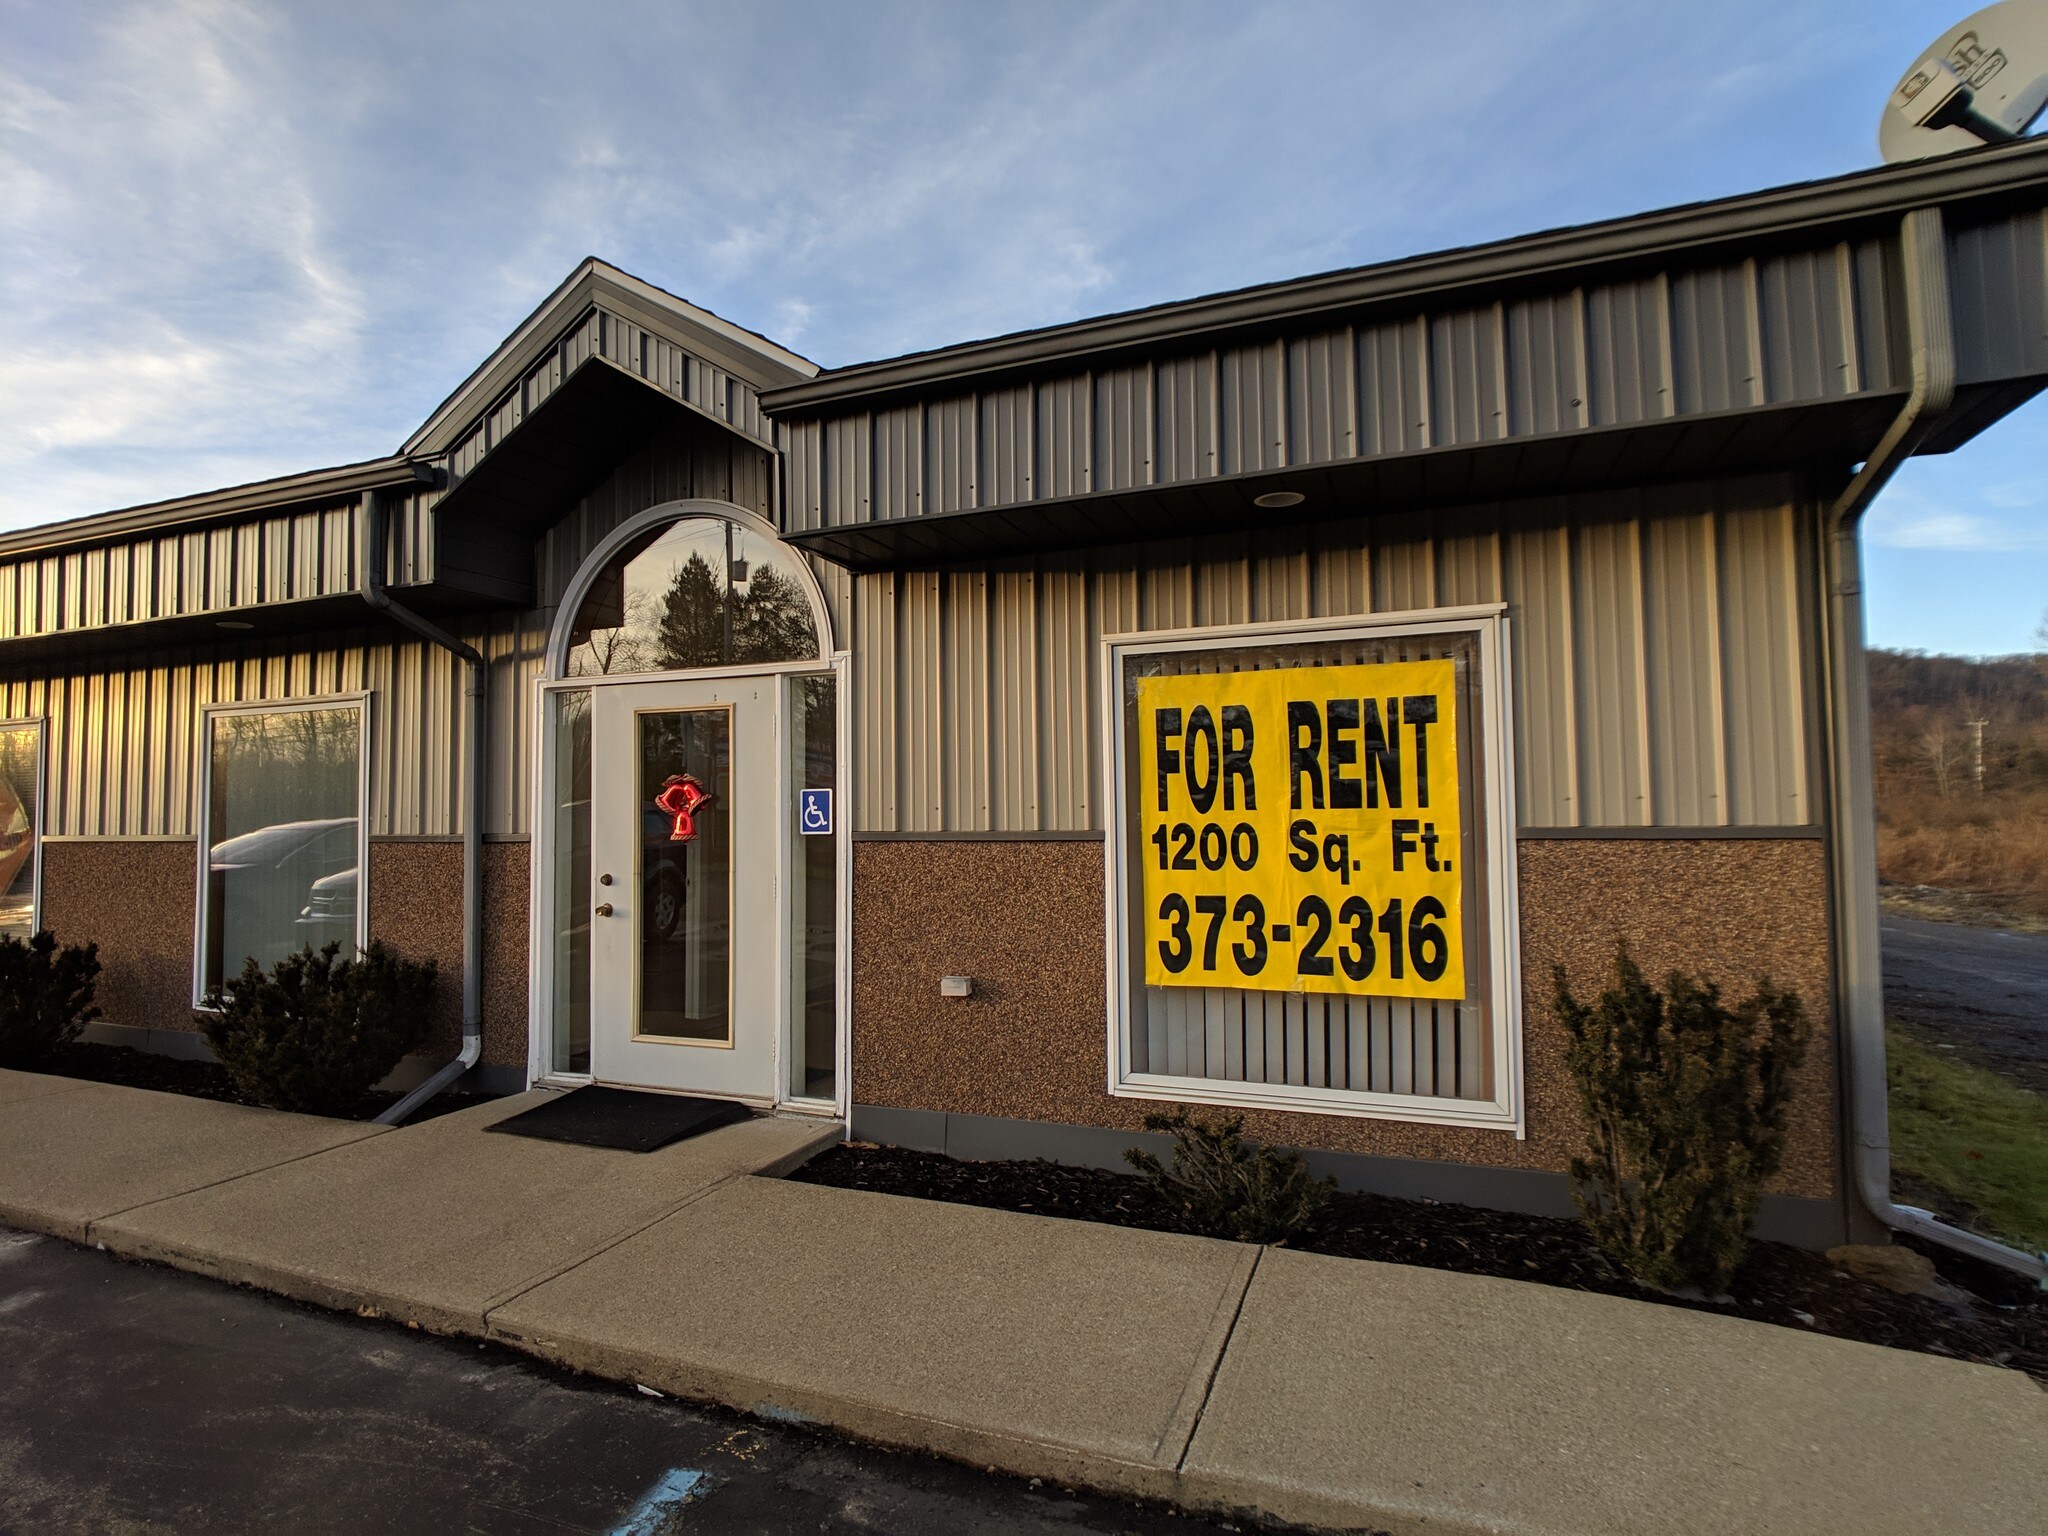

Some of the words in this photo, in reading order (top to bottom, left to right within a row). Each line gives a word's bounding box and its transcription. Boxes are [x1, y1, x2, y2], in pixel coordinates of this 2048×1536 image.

[1155, 704, 1257, 815] FOR
[1287, 694, 1438, 810] RENT
[1151, 822, 1259, 872] 1200
[1288, 818, 1361, 886] Sq.
[1391, 819, 1452, 872] Ft.
[1158, 892, 1449, 982] 373-2316
